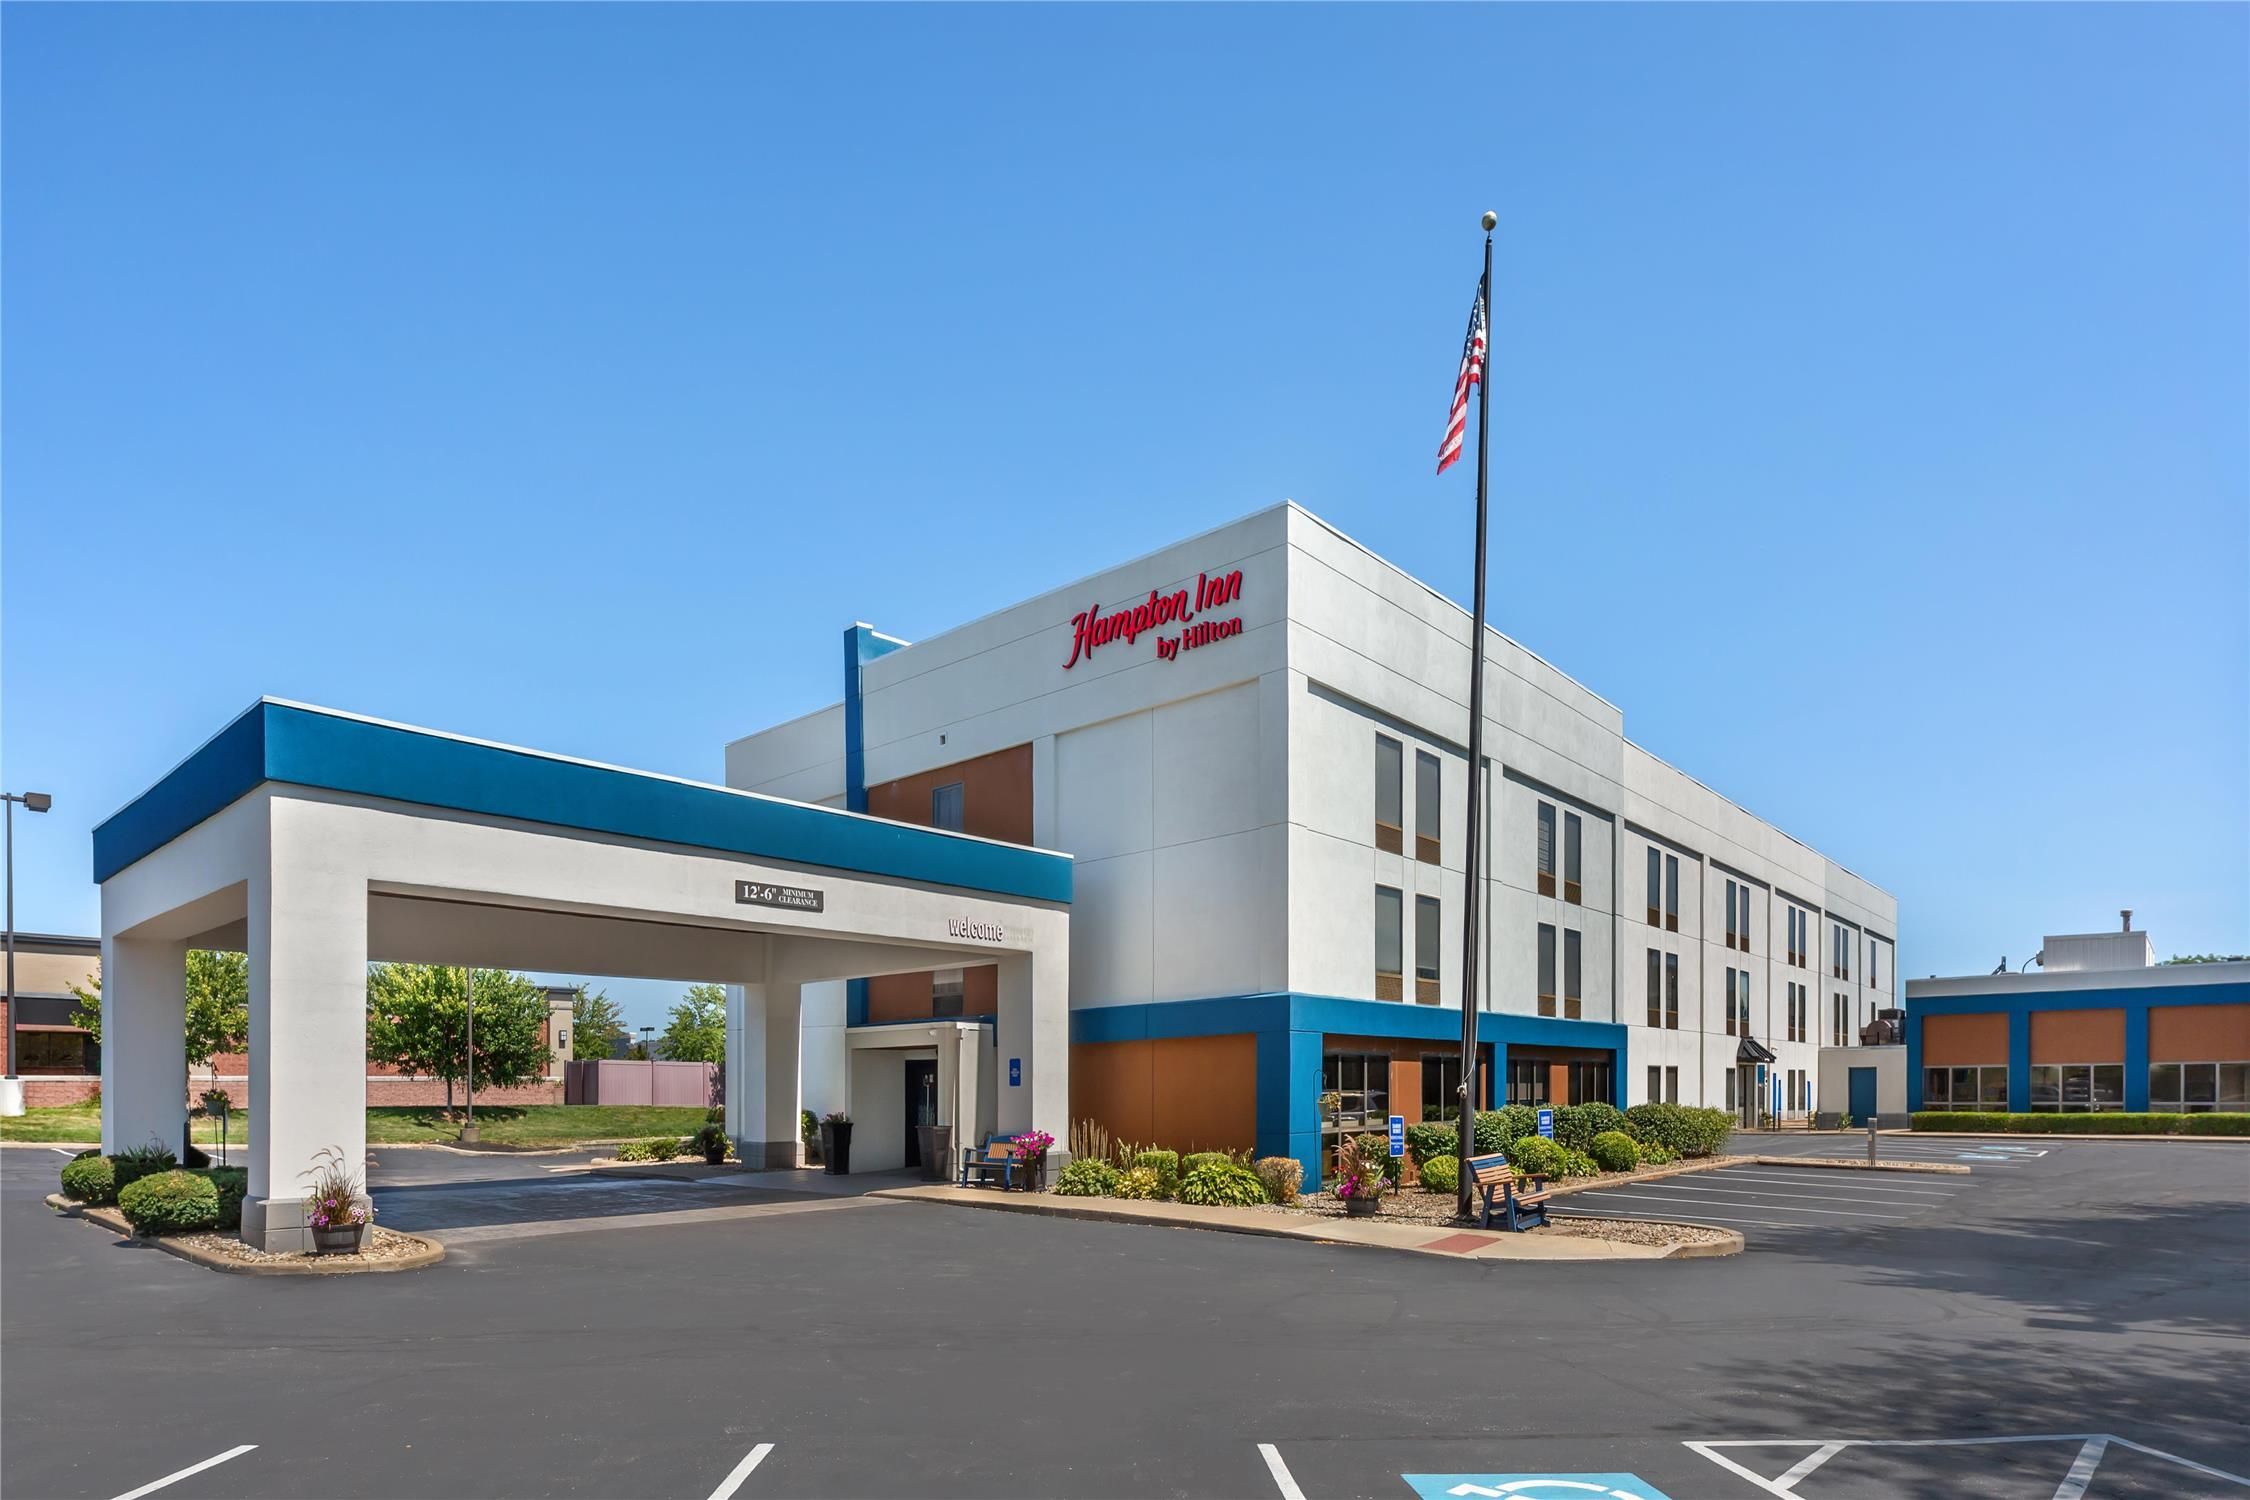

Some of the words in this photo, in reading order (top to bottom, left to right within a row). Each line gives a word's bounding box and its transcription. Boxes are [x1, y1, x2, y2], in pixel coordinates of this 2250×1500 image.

[1062, 590, 1194, 669] Hampton
[1195, 570, 1243, 613] Inn
[1157, 636, 1180, 661] by
[1182, 616, 1243, 650] Hilton
[778, 895, 818, 907] CLEARANCE
[782, 887, 814, 899] MINIMUM
[948, 916, 1004, 942] welcome
